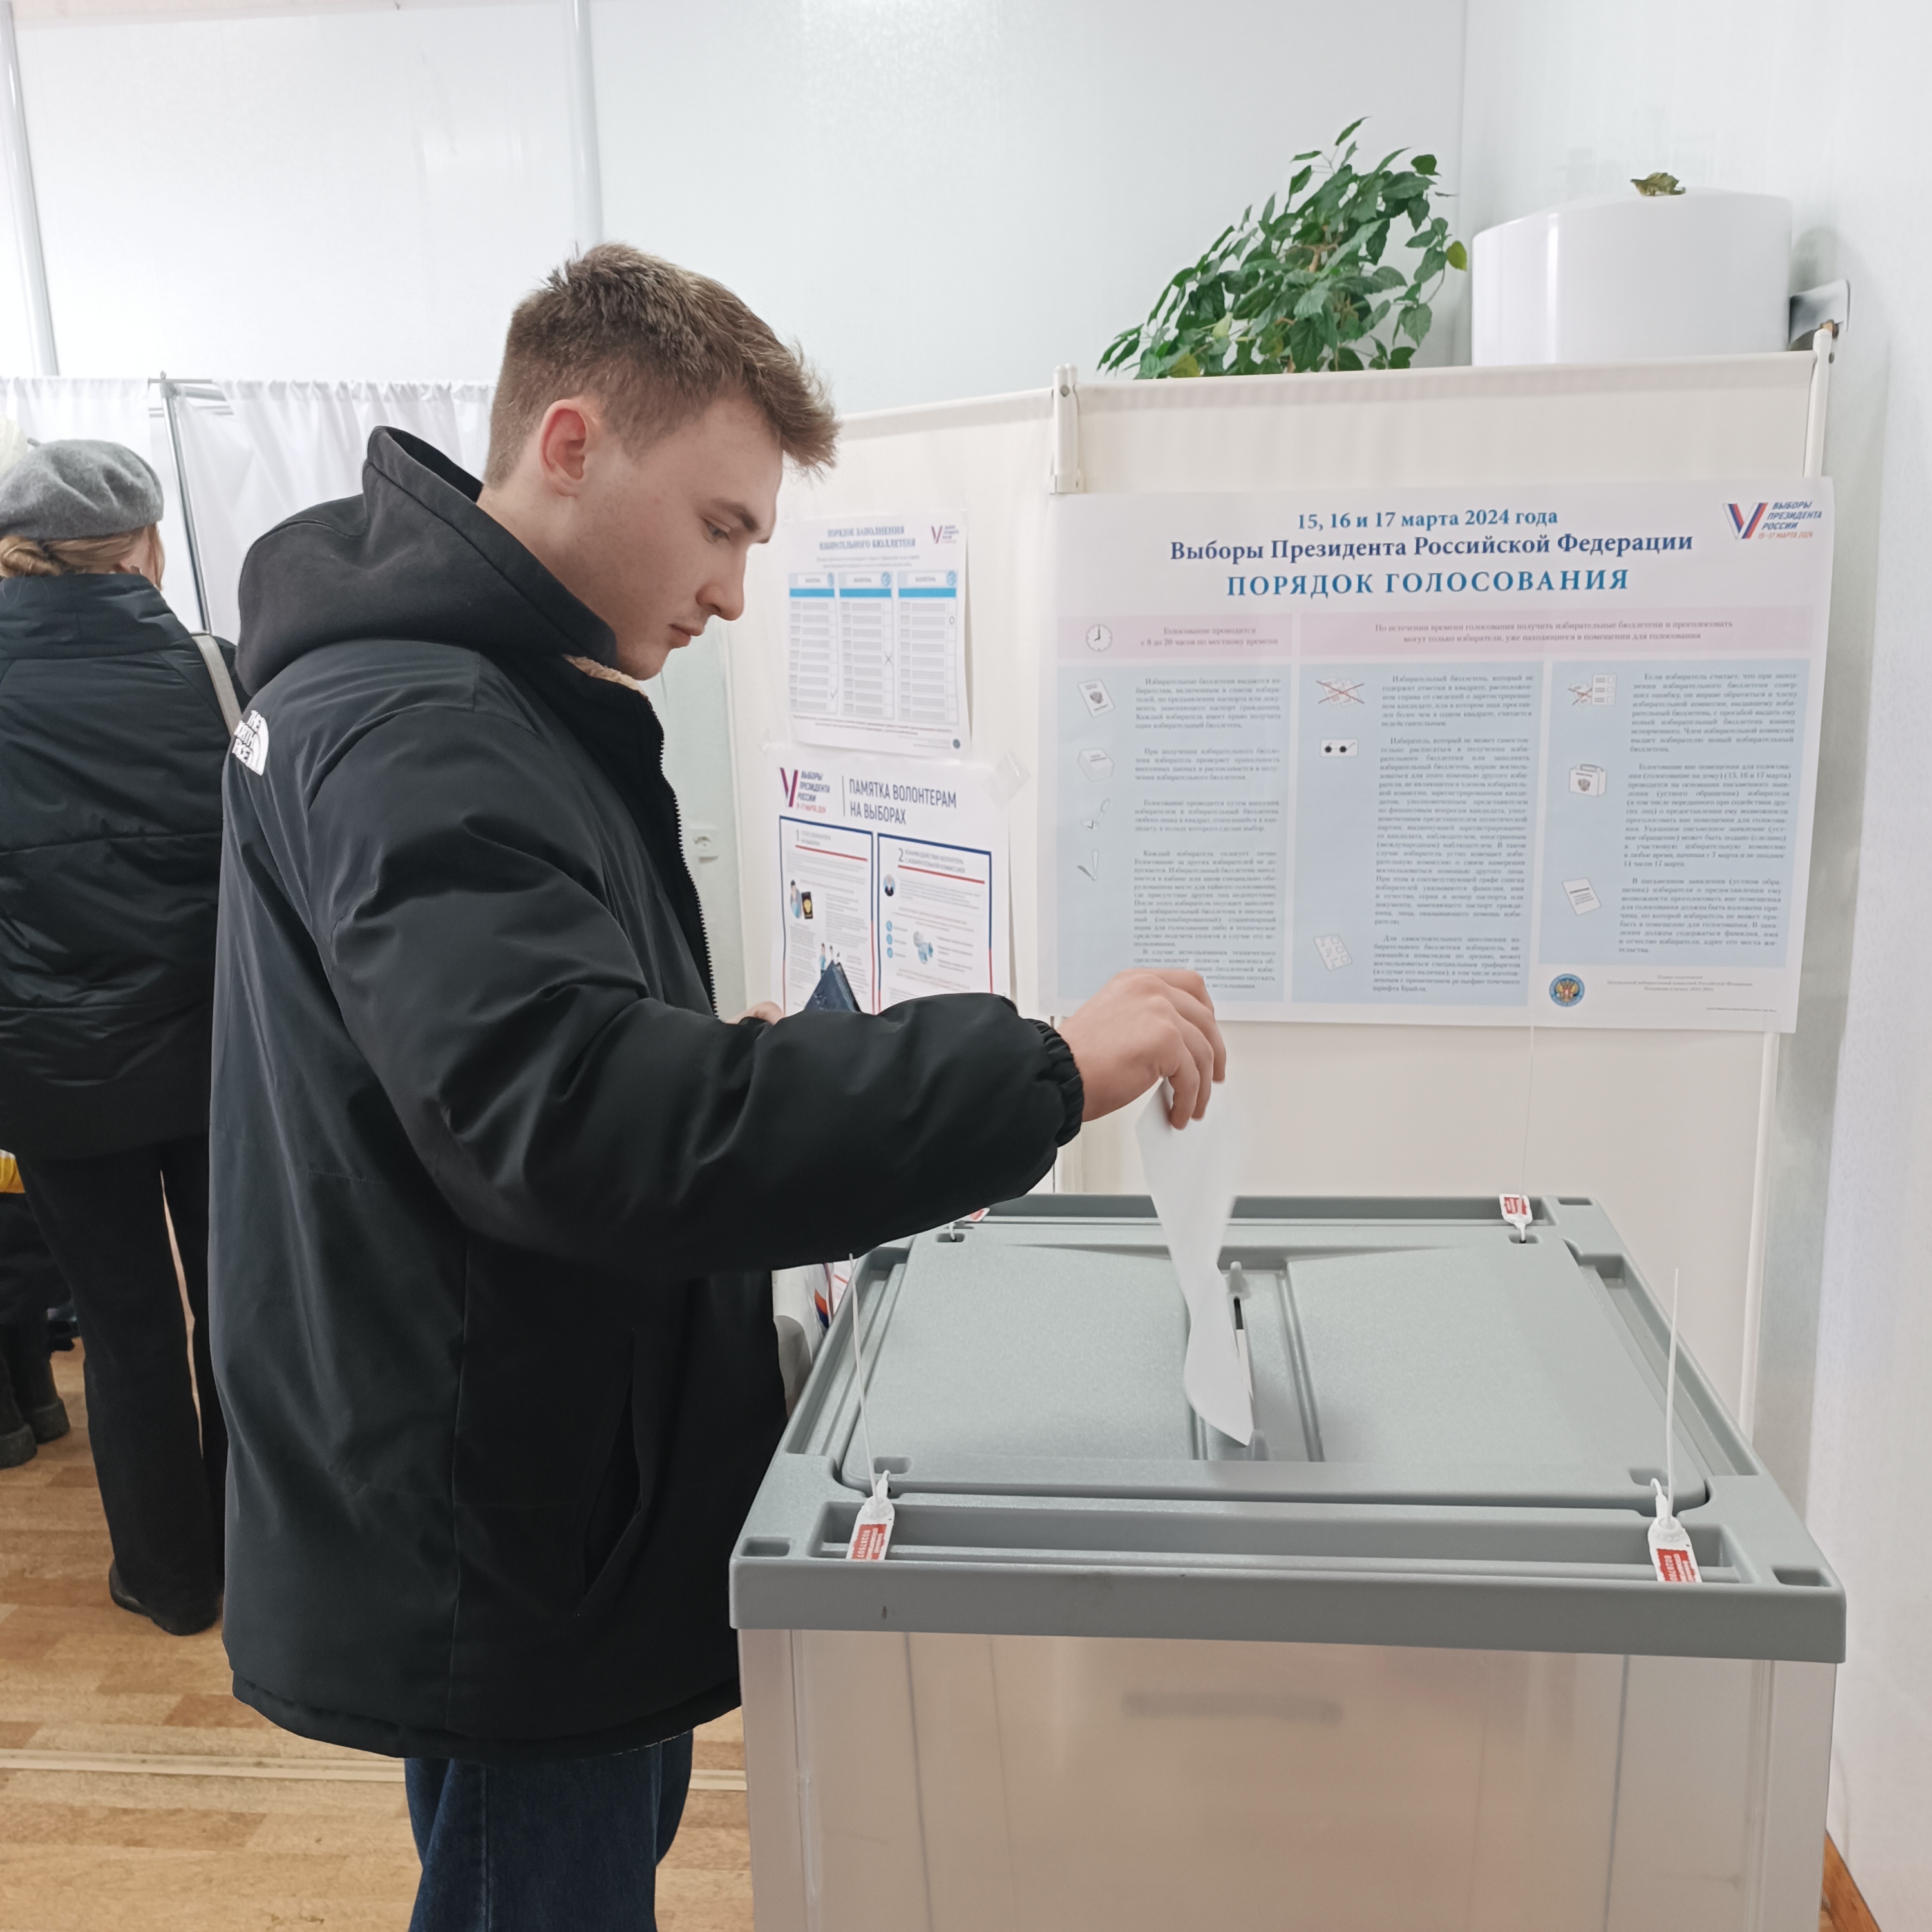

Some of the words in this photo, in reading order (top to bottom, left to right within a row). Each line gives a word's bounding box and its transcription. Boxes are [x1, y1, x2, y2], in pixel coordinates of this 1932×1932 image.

[1772, 500, 1812, 509] ВЫБОРЫ
[1298, 513, 1323, 531] 15,
[1331, 513, 1351, 529] 16
[1356, 516, 1368, 527] и
[1375, 512, 1396, 527] 17
[1401, 514, 1459, 531] марта
[1465, 509, 1509, 526] 2024
[1515, 511, 1558, 526] года
[1766, 511, 1822, 520] ПРЕЗИДЕНТА
[856, 526, 904, 536] ЗАПОЛНЕНИЯ
[1171, 540, 1263, 564] Выборы
[1271, 540, 1406, 563] Президента
[1414, 535, 1549, 555] Российской
[1558, 534, 1693, 556] Федерации
[1227, 574, 1374, 599] ПОРЯДОК
[1385, 569, 1629, 593] ГОЛОСОВАНИЯ
[800, 770, 823, 781] ВЫБОРЫ
[849, 779, 890, 800] ПАМЯТКА
[893, 784, 956, 808] ВОЛОНТЕРАМ
[850, 801, 862, 818] НА
[864, 803, 907, 825] ВЫБОРАХ
[898, 848, 904, 863] 2
